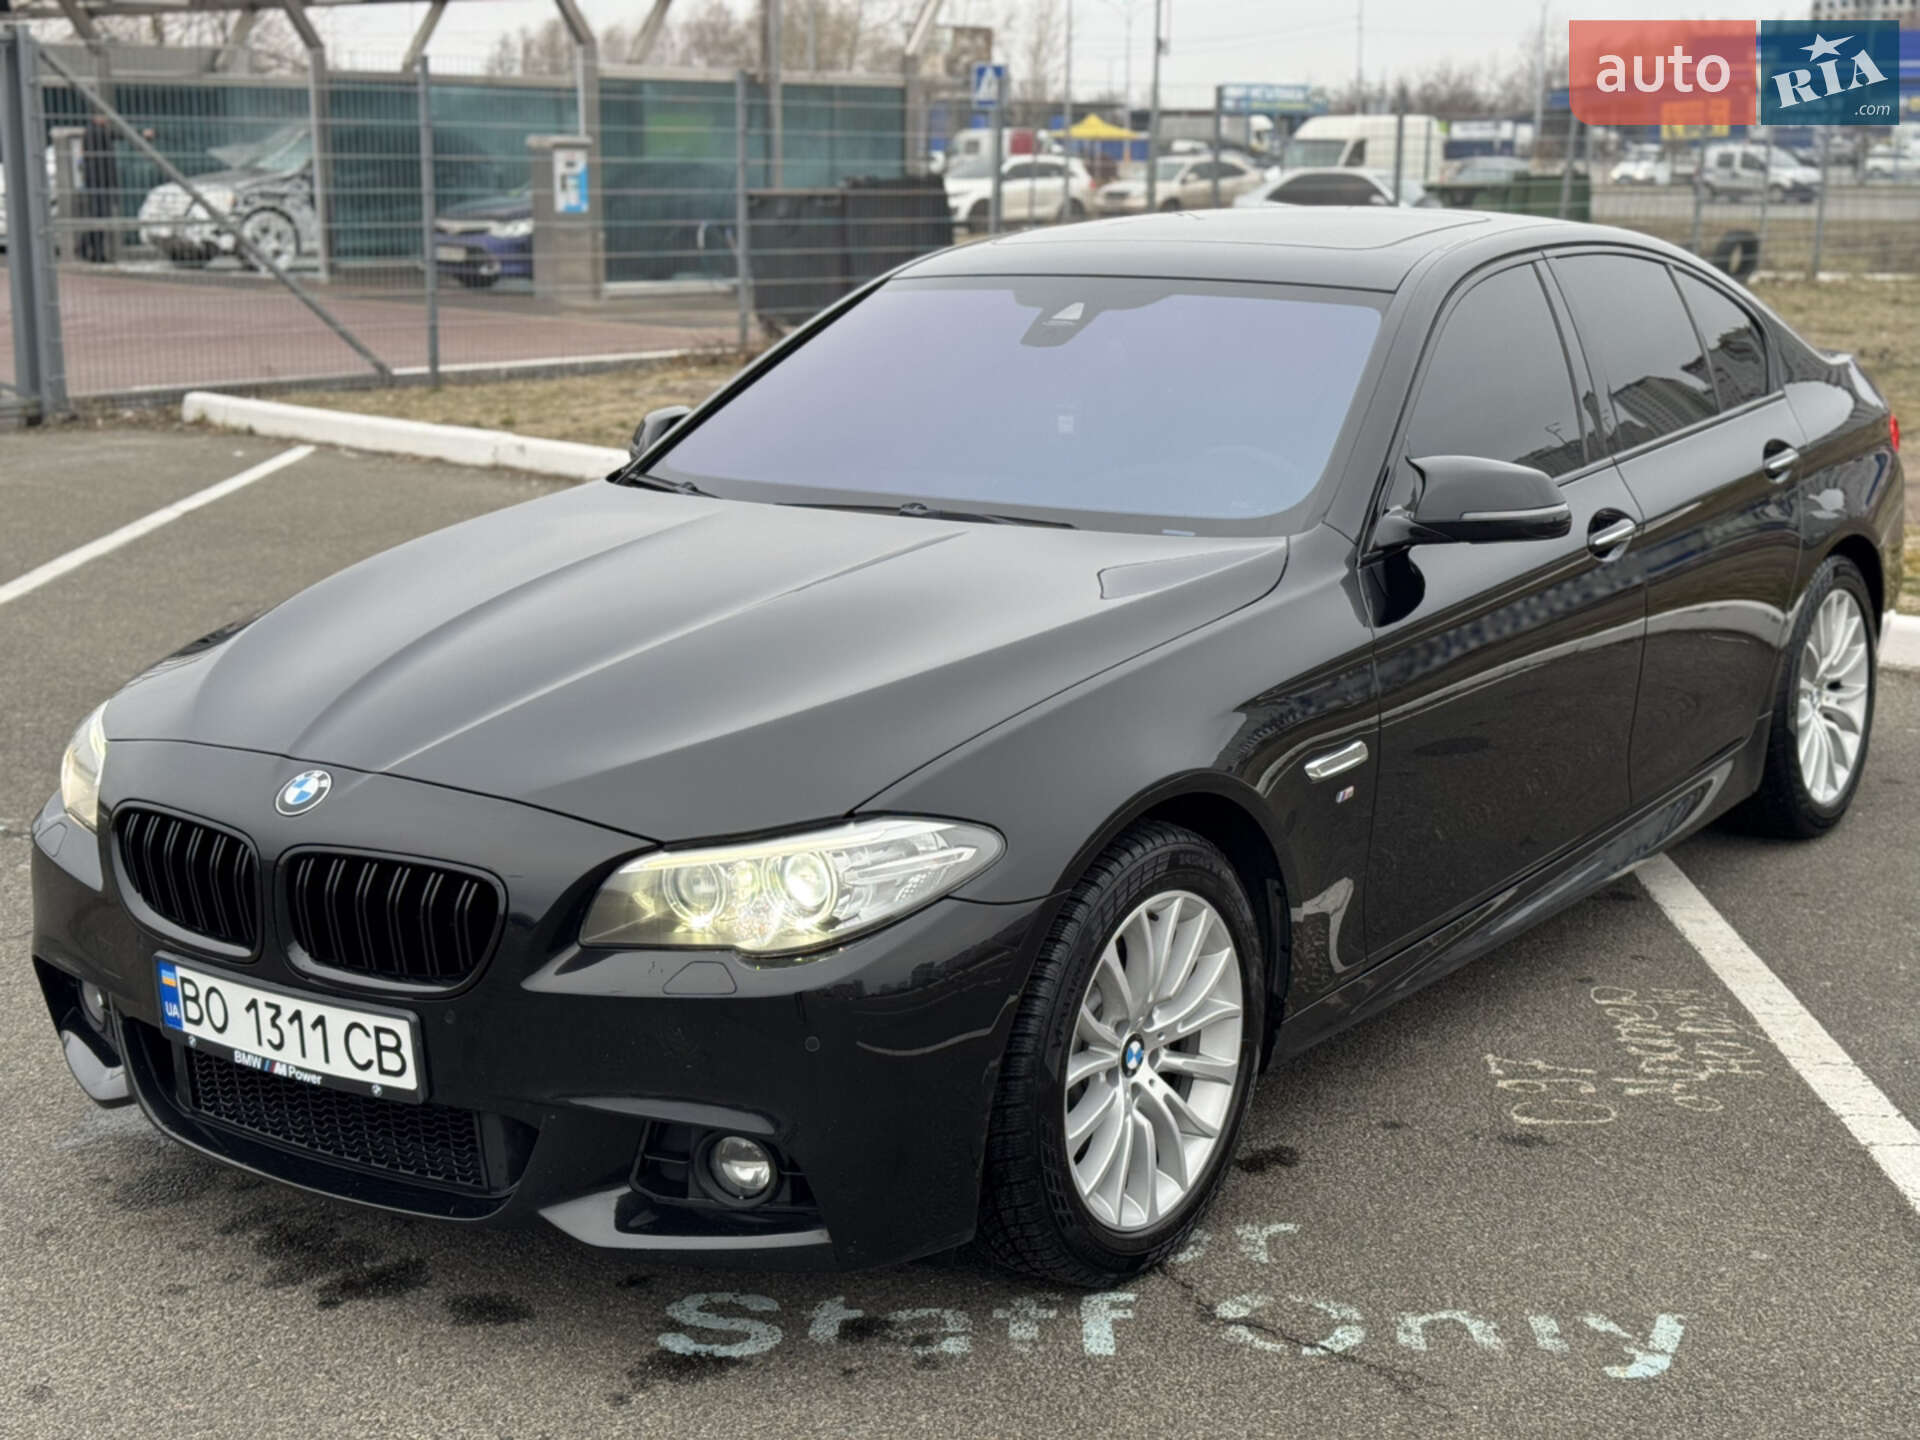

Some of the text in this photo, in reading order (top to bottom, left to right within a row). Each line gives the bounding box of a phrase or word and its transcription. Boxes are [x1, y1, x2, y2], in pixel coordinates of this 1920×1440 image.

[165, 1001, 181, 1020] UA
[180, 976, 407, 1078] BO 1311 CB
[233, 1050, 262, 1069] BMW
